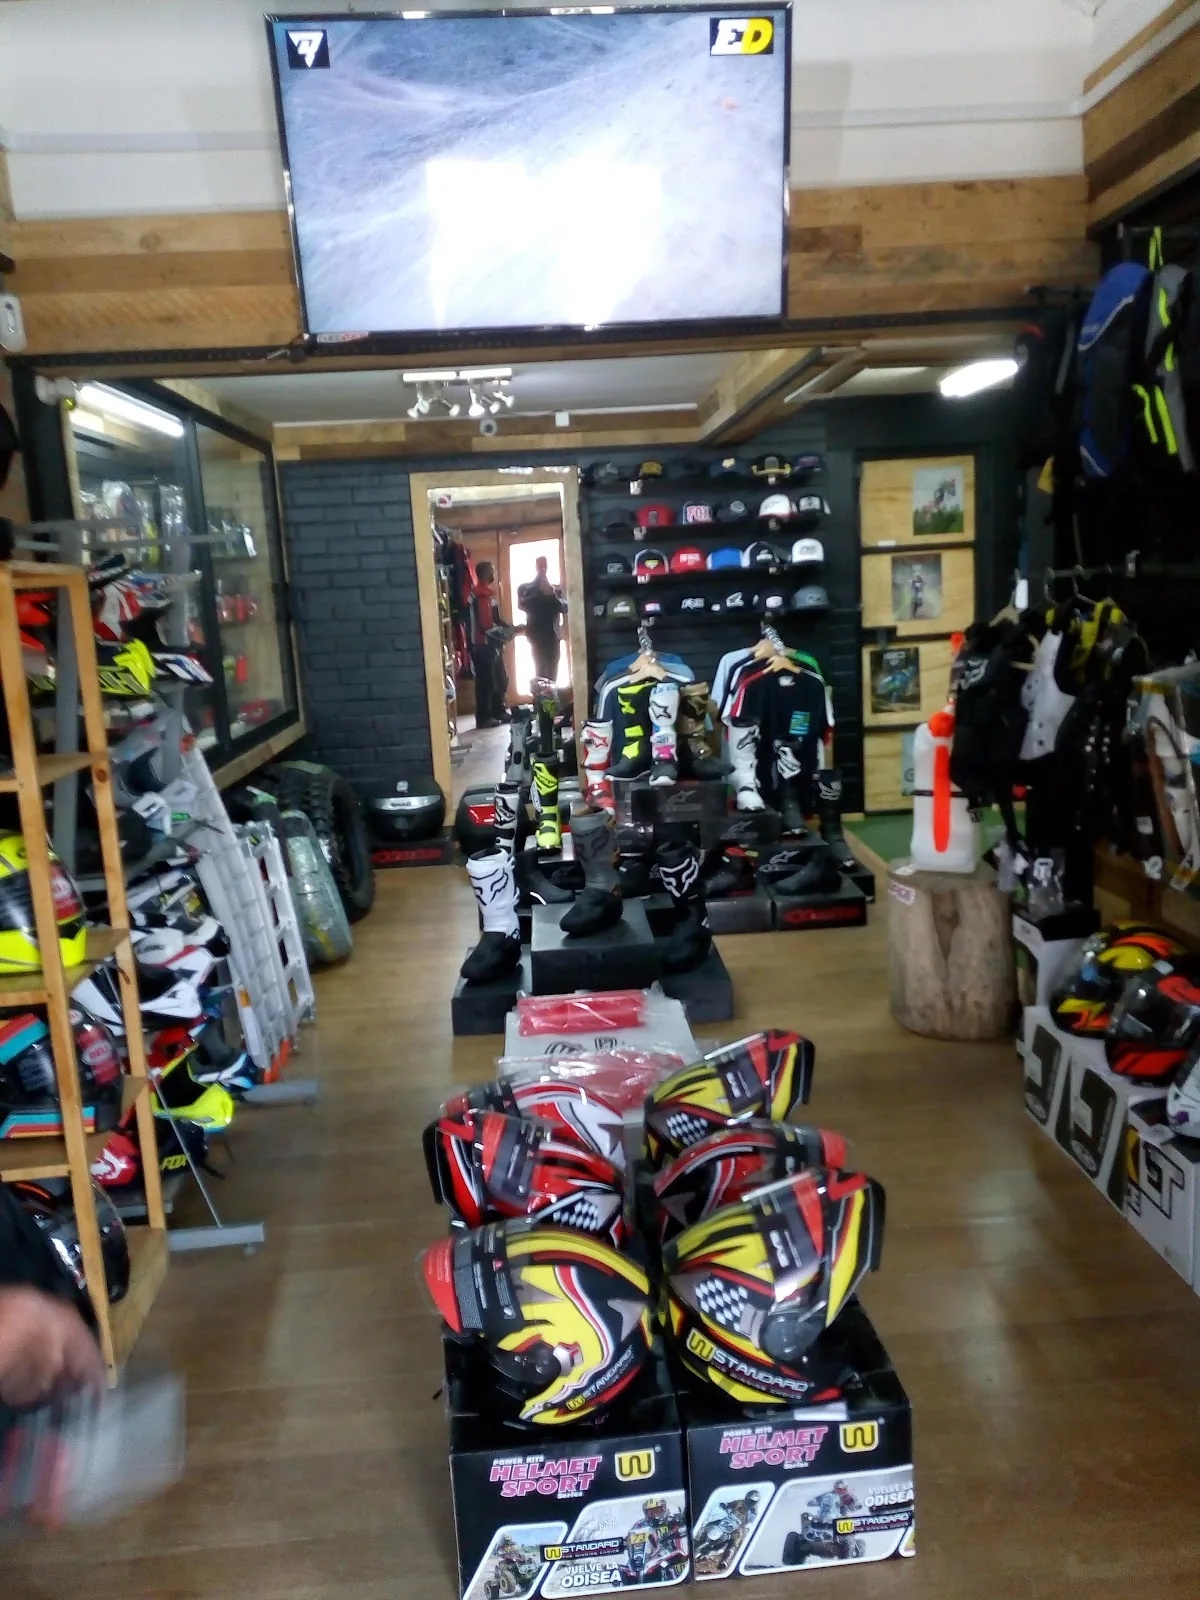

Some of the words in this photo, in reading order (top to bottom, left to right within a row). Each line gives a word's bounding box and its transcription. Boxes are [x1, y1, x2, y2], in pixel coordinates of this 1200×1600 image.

[686, 504, 712, 523] FOX
[161, 1153, 188, 1170] FOX
[719, 1426, 829, 1454] HELMET
[493, 1457, 523, 1466] POWER
[526, 1454, 545, 1463] KITS
[729, 1444, 820, 1469] SPORT
[489, 1455, 602, 1482] HELMET
[500, 1473, 594, 1498] SPORT
[864, 1489, 915, 1507] ODISEA
[565, 1563, 602, 1575] VUELVE
[561, 1571, 622, 1588] ODISEA
